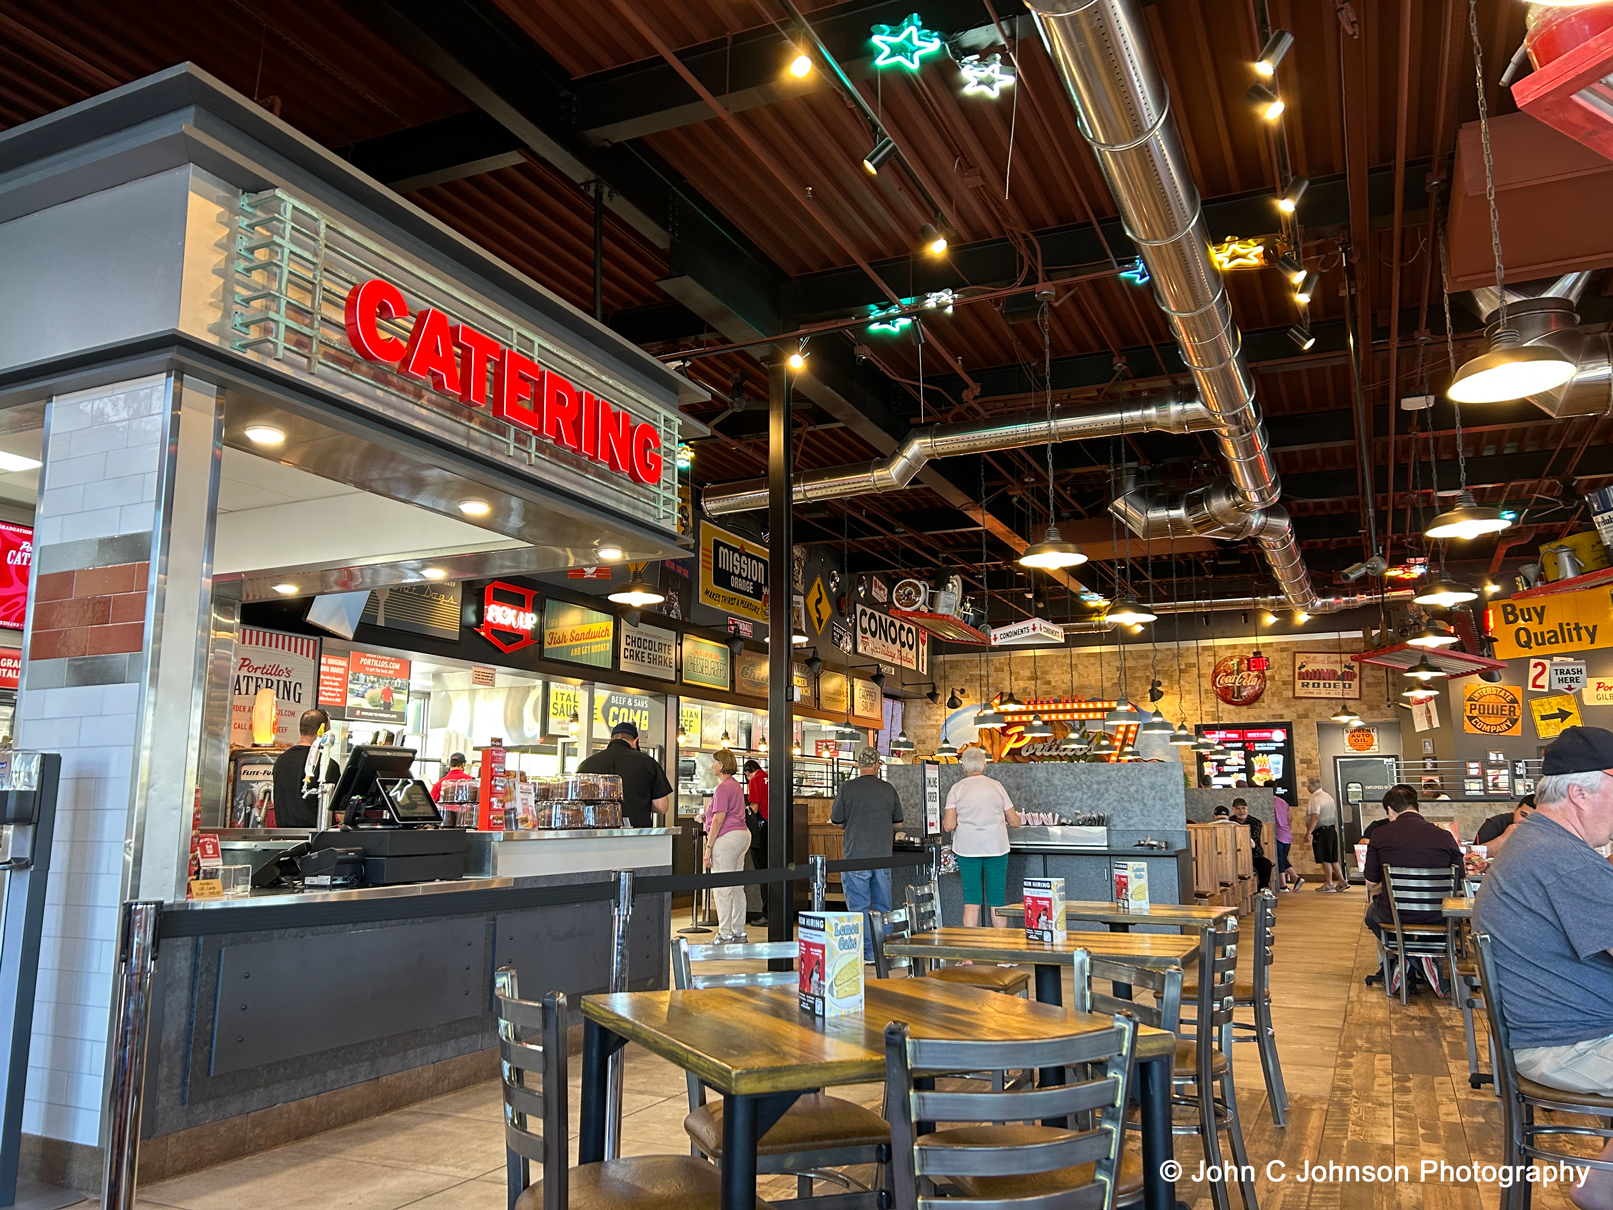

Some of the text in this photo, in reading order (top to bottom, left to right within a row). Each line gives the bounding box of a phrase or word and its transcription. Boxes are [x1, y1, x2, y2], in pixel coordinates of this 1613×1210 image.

[345, 279, 662, 484] CATERING
[7, 550, 32, 566] CAT
[719, 546, 764, 584] MISSION
[731, 575, 753, 593] ORANGE
[705, 588, 721, 602] MAKES
[721, 595, 736, 605] THIRST
[740, 600, 760, 614] PLEASURE
[1502, 603, 1546, 625] Buy
[547, 626, 611, 645] Fish Sandwich
[859, 608, 914, 651] CONOCO
[1000, 626, 1030, 640] CONDIMENTS
[1043, 626, 1060, 638] CONDIMENTS
[1515, 622, 1598, 650] Quality
[571, 647, 580, 656] AND
[581, 645, 590, 654] GET
[625, 634, 672, 655] CHOCOLATE
[623, 648, 673, 668] CAKE SHAKE
[694, 649, 720, 660] SUPER
[238, 657, 292, 678] Portillo's
[328, 658, 347, 666] ORIGINAL
[360, 657, 400, 670] PORTILLOS.COM
[1250, 658, 1267, 670] EXIT
[1216, 671, 1260, 690] Coca-Cola
[1298, 668, 1357, 681] ROUND-UP
[1531, 661, 1546, 689] 2
[1558, 676, 1581, 684] HERE
[611, 695, 649, 708] BEEF & SAUS
[859, 688, 876, 702] CHOPPED
[1471, 687, 1513, 702] INTERSTATE
[862, 701, 874, 713] SALAD
[1470, 703, 1516, 716] POWER
[681, 709, 699, 720] LIAN
[1471, 717, 1512, 733] COMPANY
[806, 918, 824, 928] HIRING
[834, 922, 859, 936] Lemon
[838, 936, 857, 950] Cake
